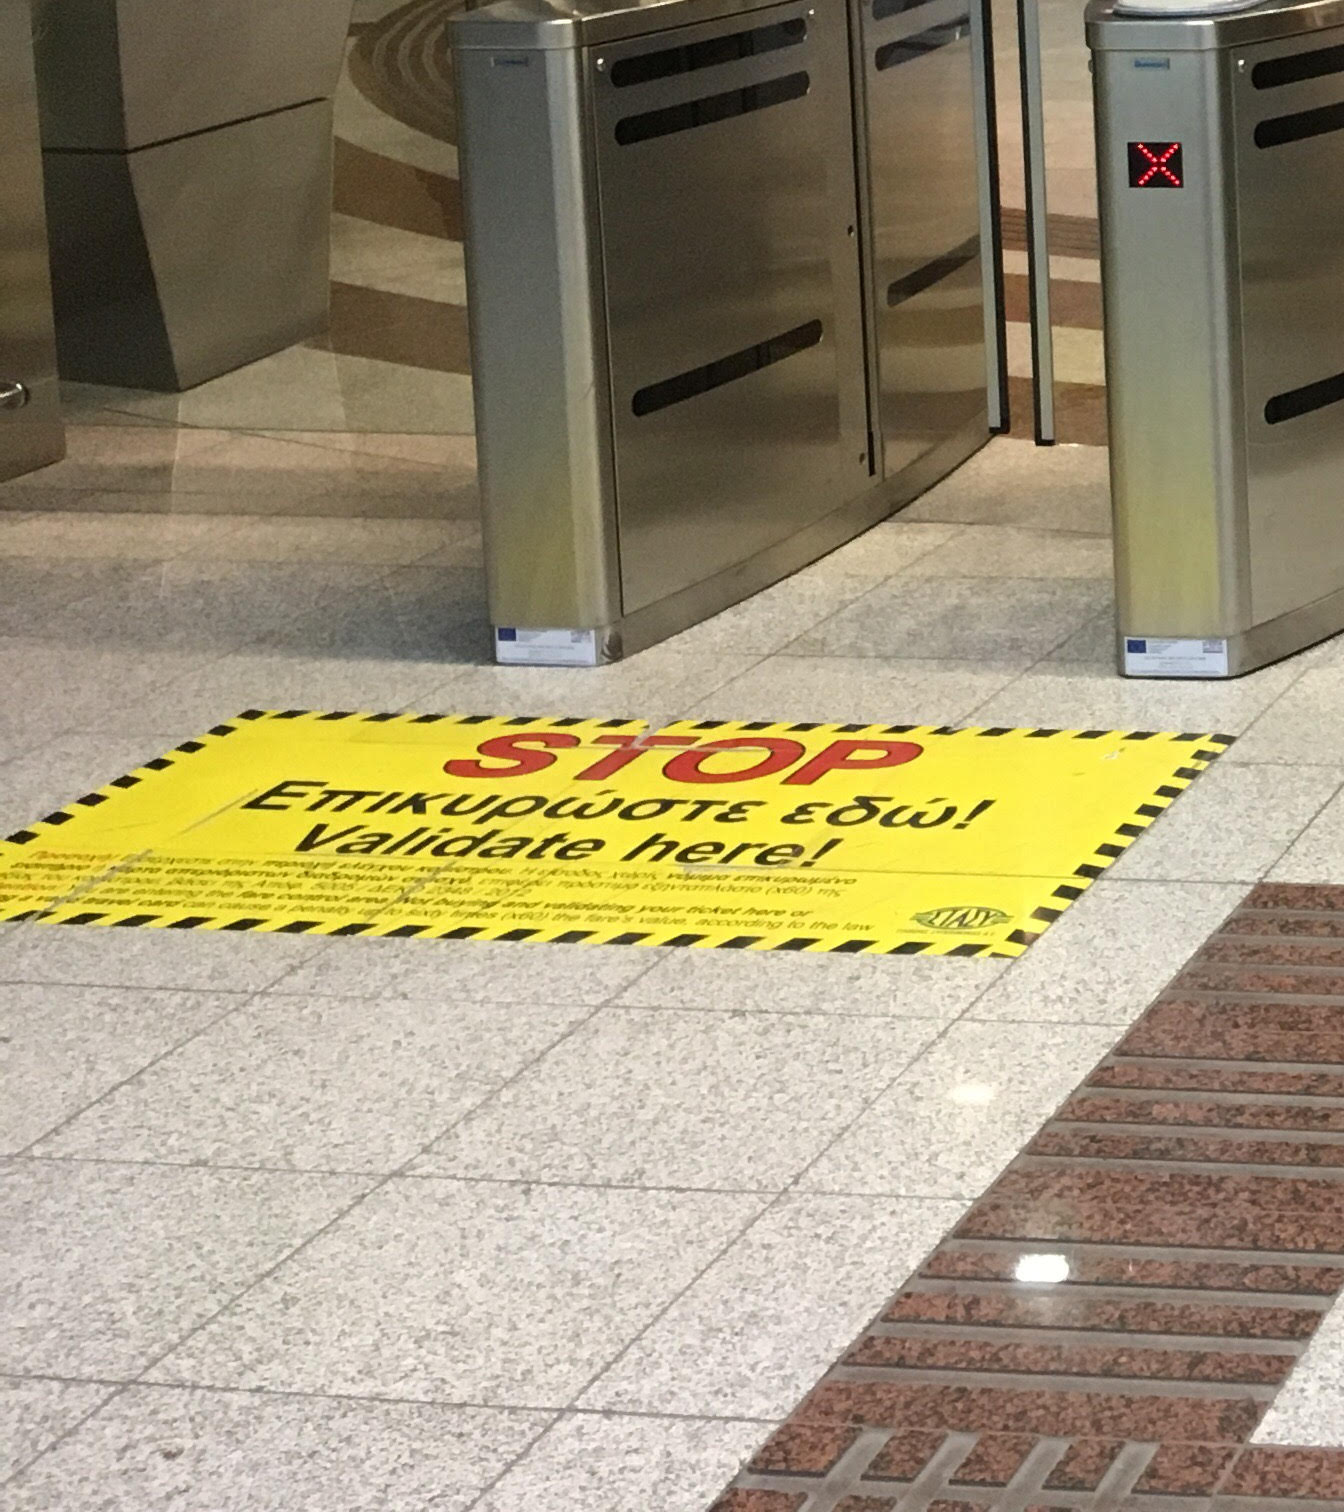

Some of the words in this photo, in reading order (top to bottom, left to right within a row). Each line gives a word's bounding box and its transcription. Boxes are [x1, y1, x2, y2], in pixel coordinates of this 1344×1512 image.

[443, 732, 925, 787] STOP
[240, 779, 767, 826] Επικυρώστε
[780, 795, 997, 830] εδώ!
[295, 822, 605, 862] Validate
[621, 834, 844, 869] here!
